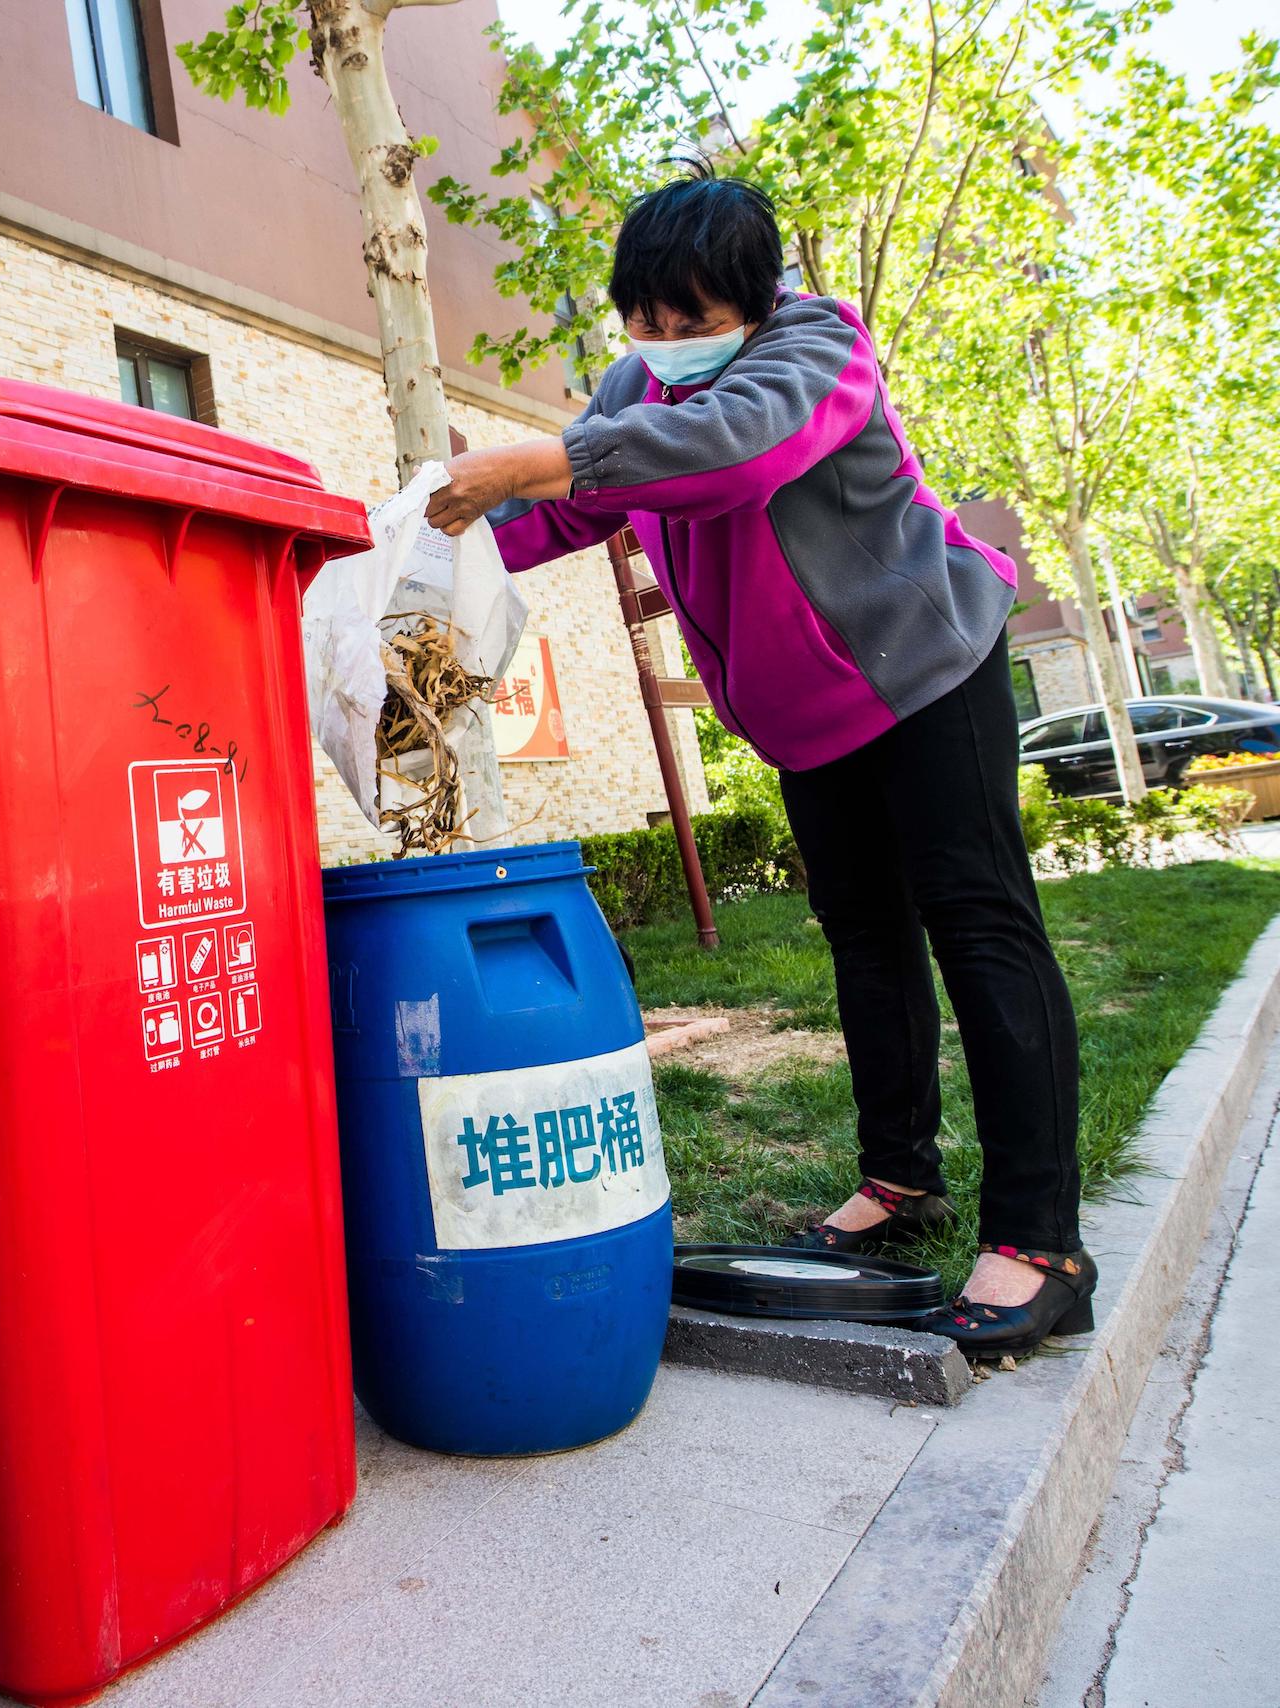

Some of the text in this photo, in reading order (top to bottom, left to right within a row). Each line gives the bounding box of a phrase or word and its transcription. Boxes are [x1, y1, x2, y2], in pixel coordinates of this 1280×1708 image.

[156, 862, 231, 896] 有害垃圾
[158, 895, 233, 919] Harmful Waste
[192, 981, 216, 994] 电子产品
[147, 991, 170, 1004] 废电池
[199, 1045, 220, 1060] 废灯管
[150, 1056, 181, 1073] 过期药品
[457, 1090, 644, 1196] 堆肥桶
